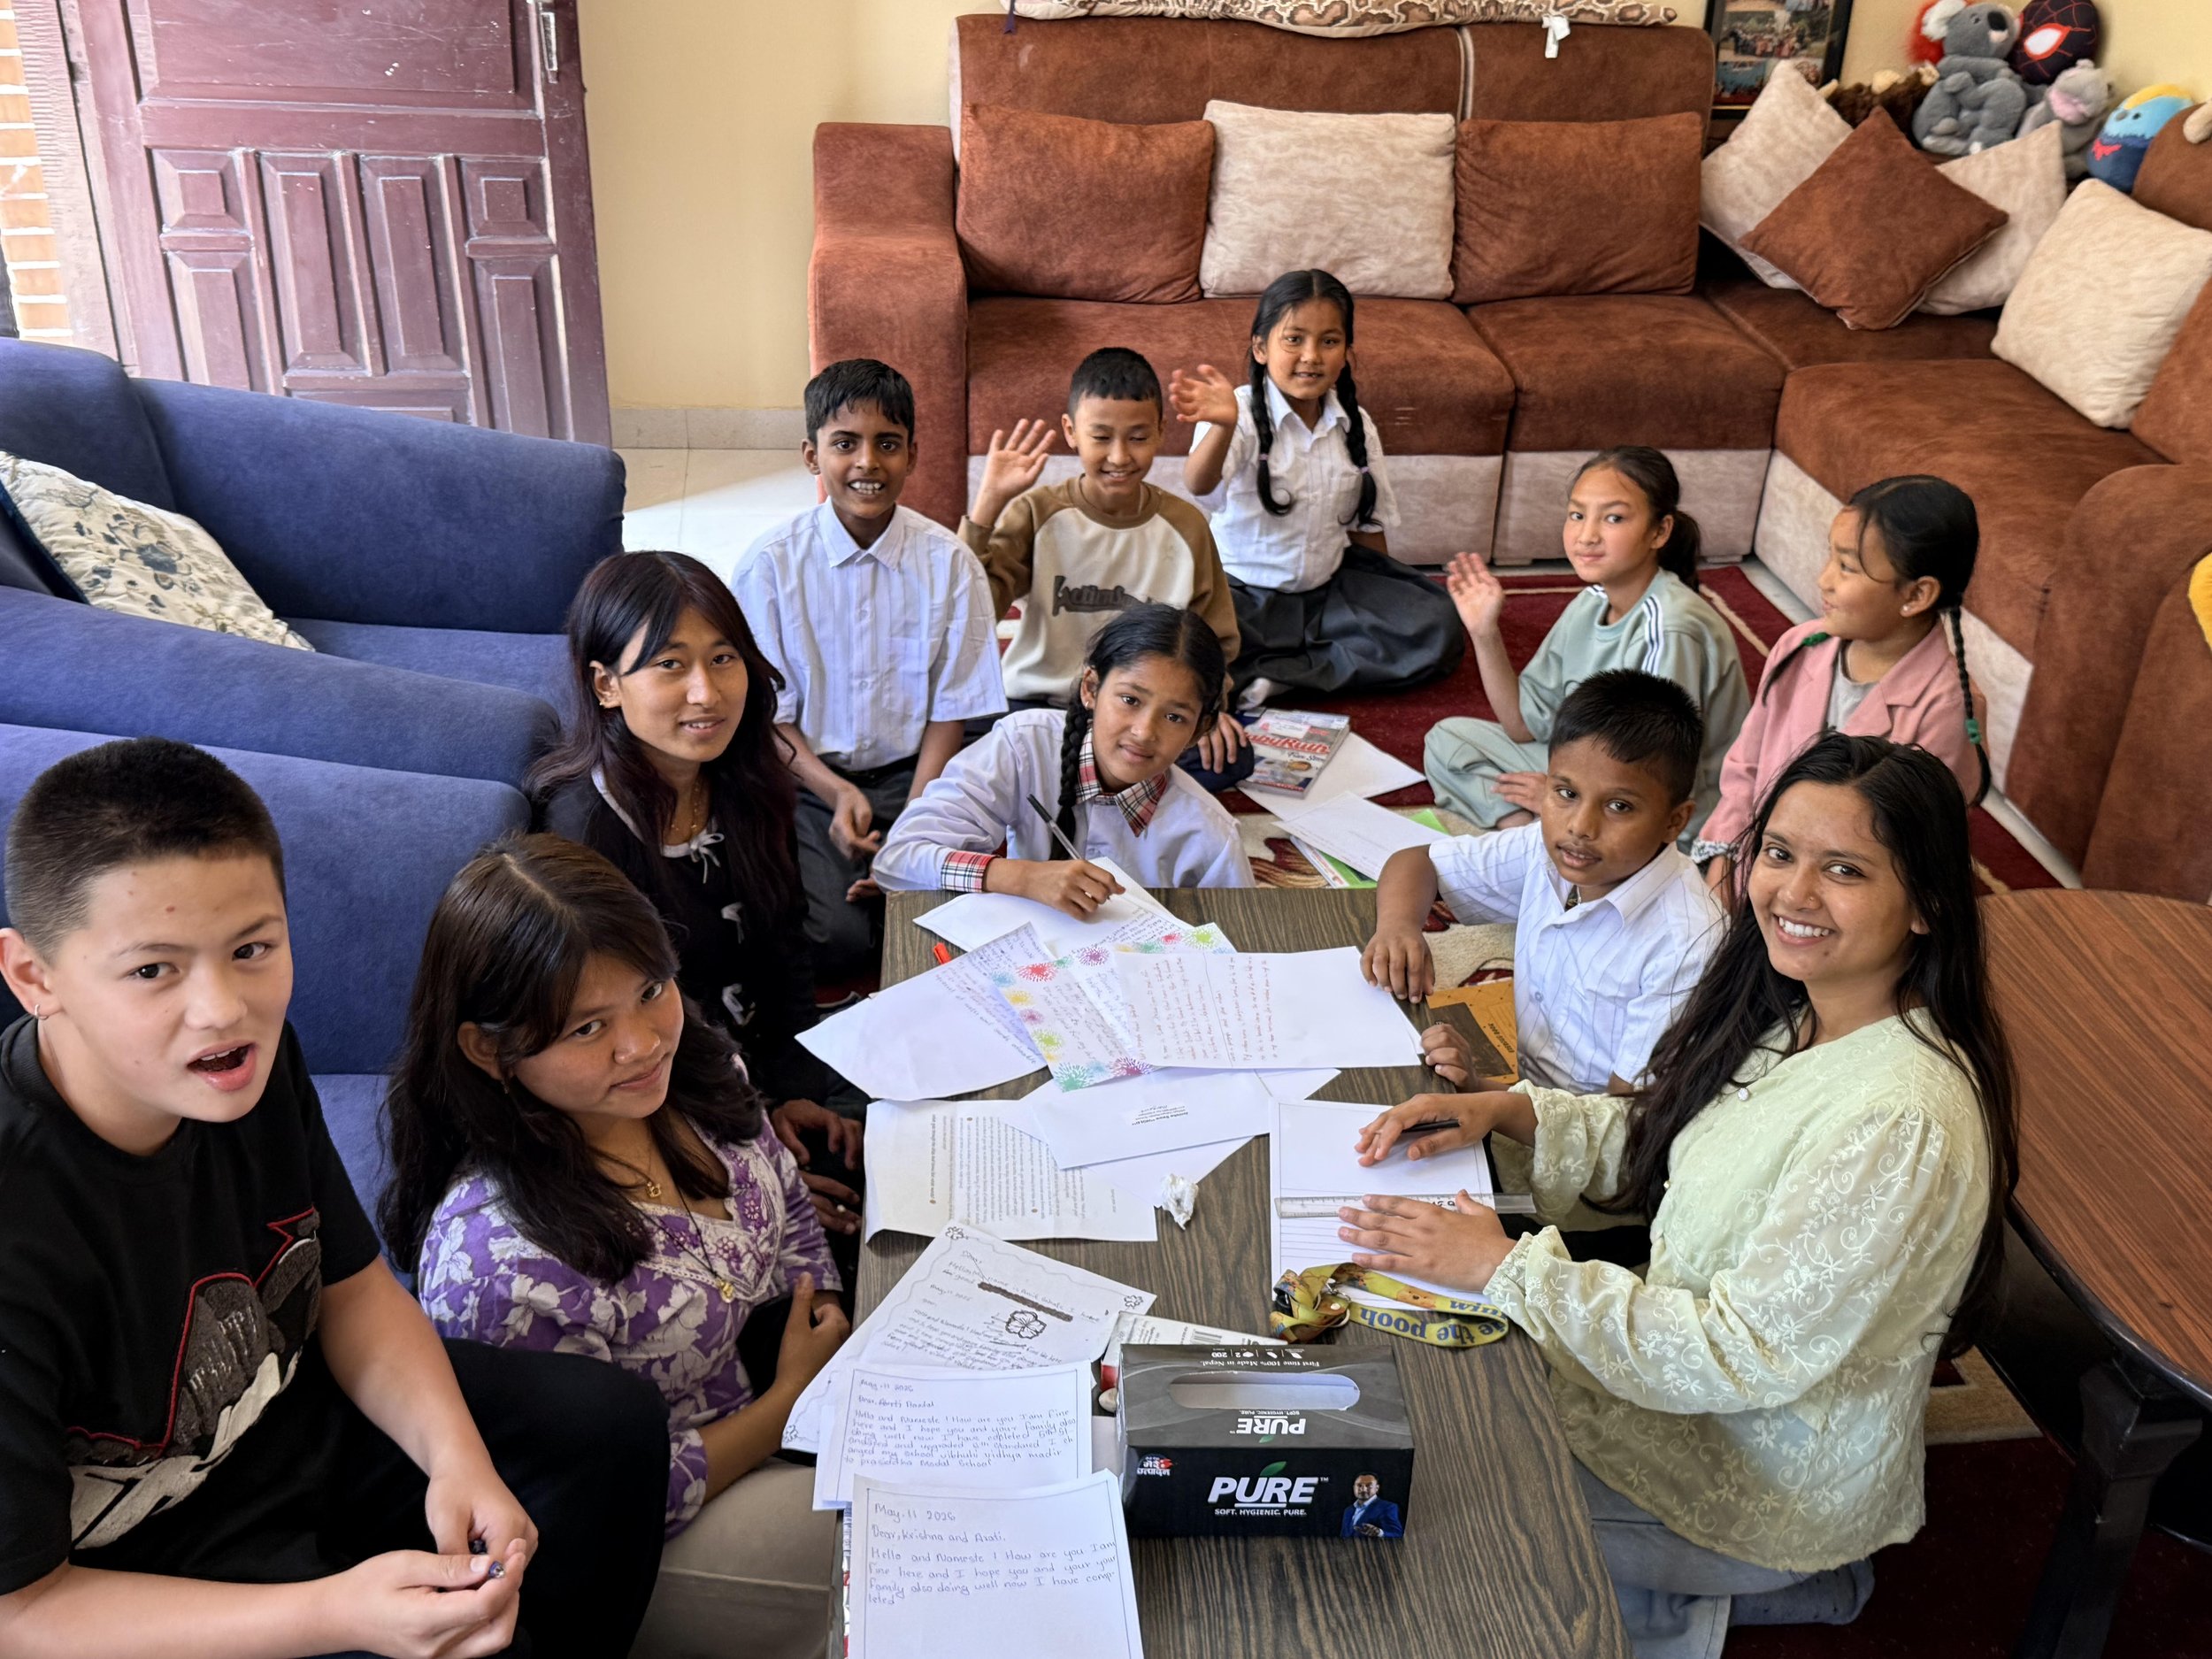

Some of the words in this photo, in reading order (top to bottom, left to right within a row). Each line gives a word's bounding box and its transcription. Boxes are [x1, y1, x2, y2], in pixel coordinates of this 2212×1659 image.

[1360, 1307, 1428, 1339] pooh
[1236, 1418, 1307, 1435] PURE
[1207, 1477, 1319, 1503] PURE
[948, 1531, 968, 1543] and
[872, 1546, 902, 1560] Hello
[911, 1552, 931, 1562] and
[1005, 1550, 1031, 1560] How
[1064, 1548, 1084, 1561] you
[899, 1566, 923, 1578] here
[928, 1567, 949, 1578] and
[954, 1568, 965, 1578] I
[975, 1567, 1000, 1578] hope
[1008, 1568, 1029, 1580] you
[1033, 1562, 1055, 1573] and
[1064, 1562, 1091, 1575] your
[911, 1582, 933, 1593] also
[937, 1582, 970, 1596] doing
[975, 1580, 998, 1590] well
[1034, 1576, 1044, 1586] I
[1052, 1575, 1079, 1586] have
